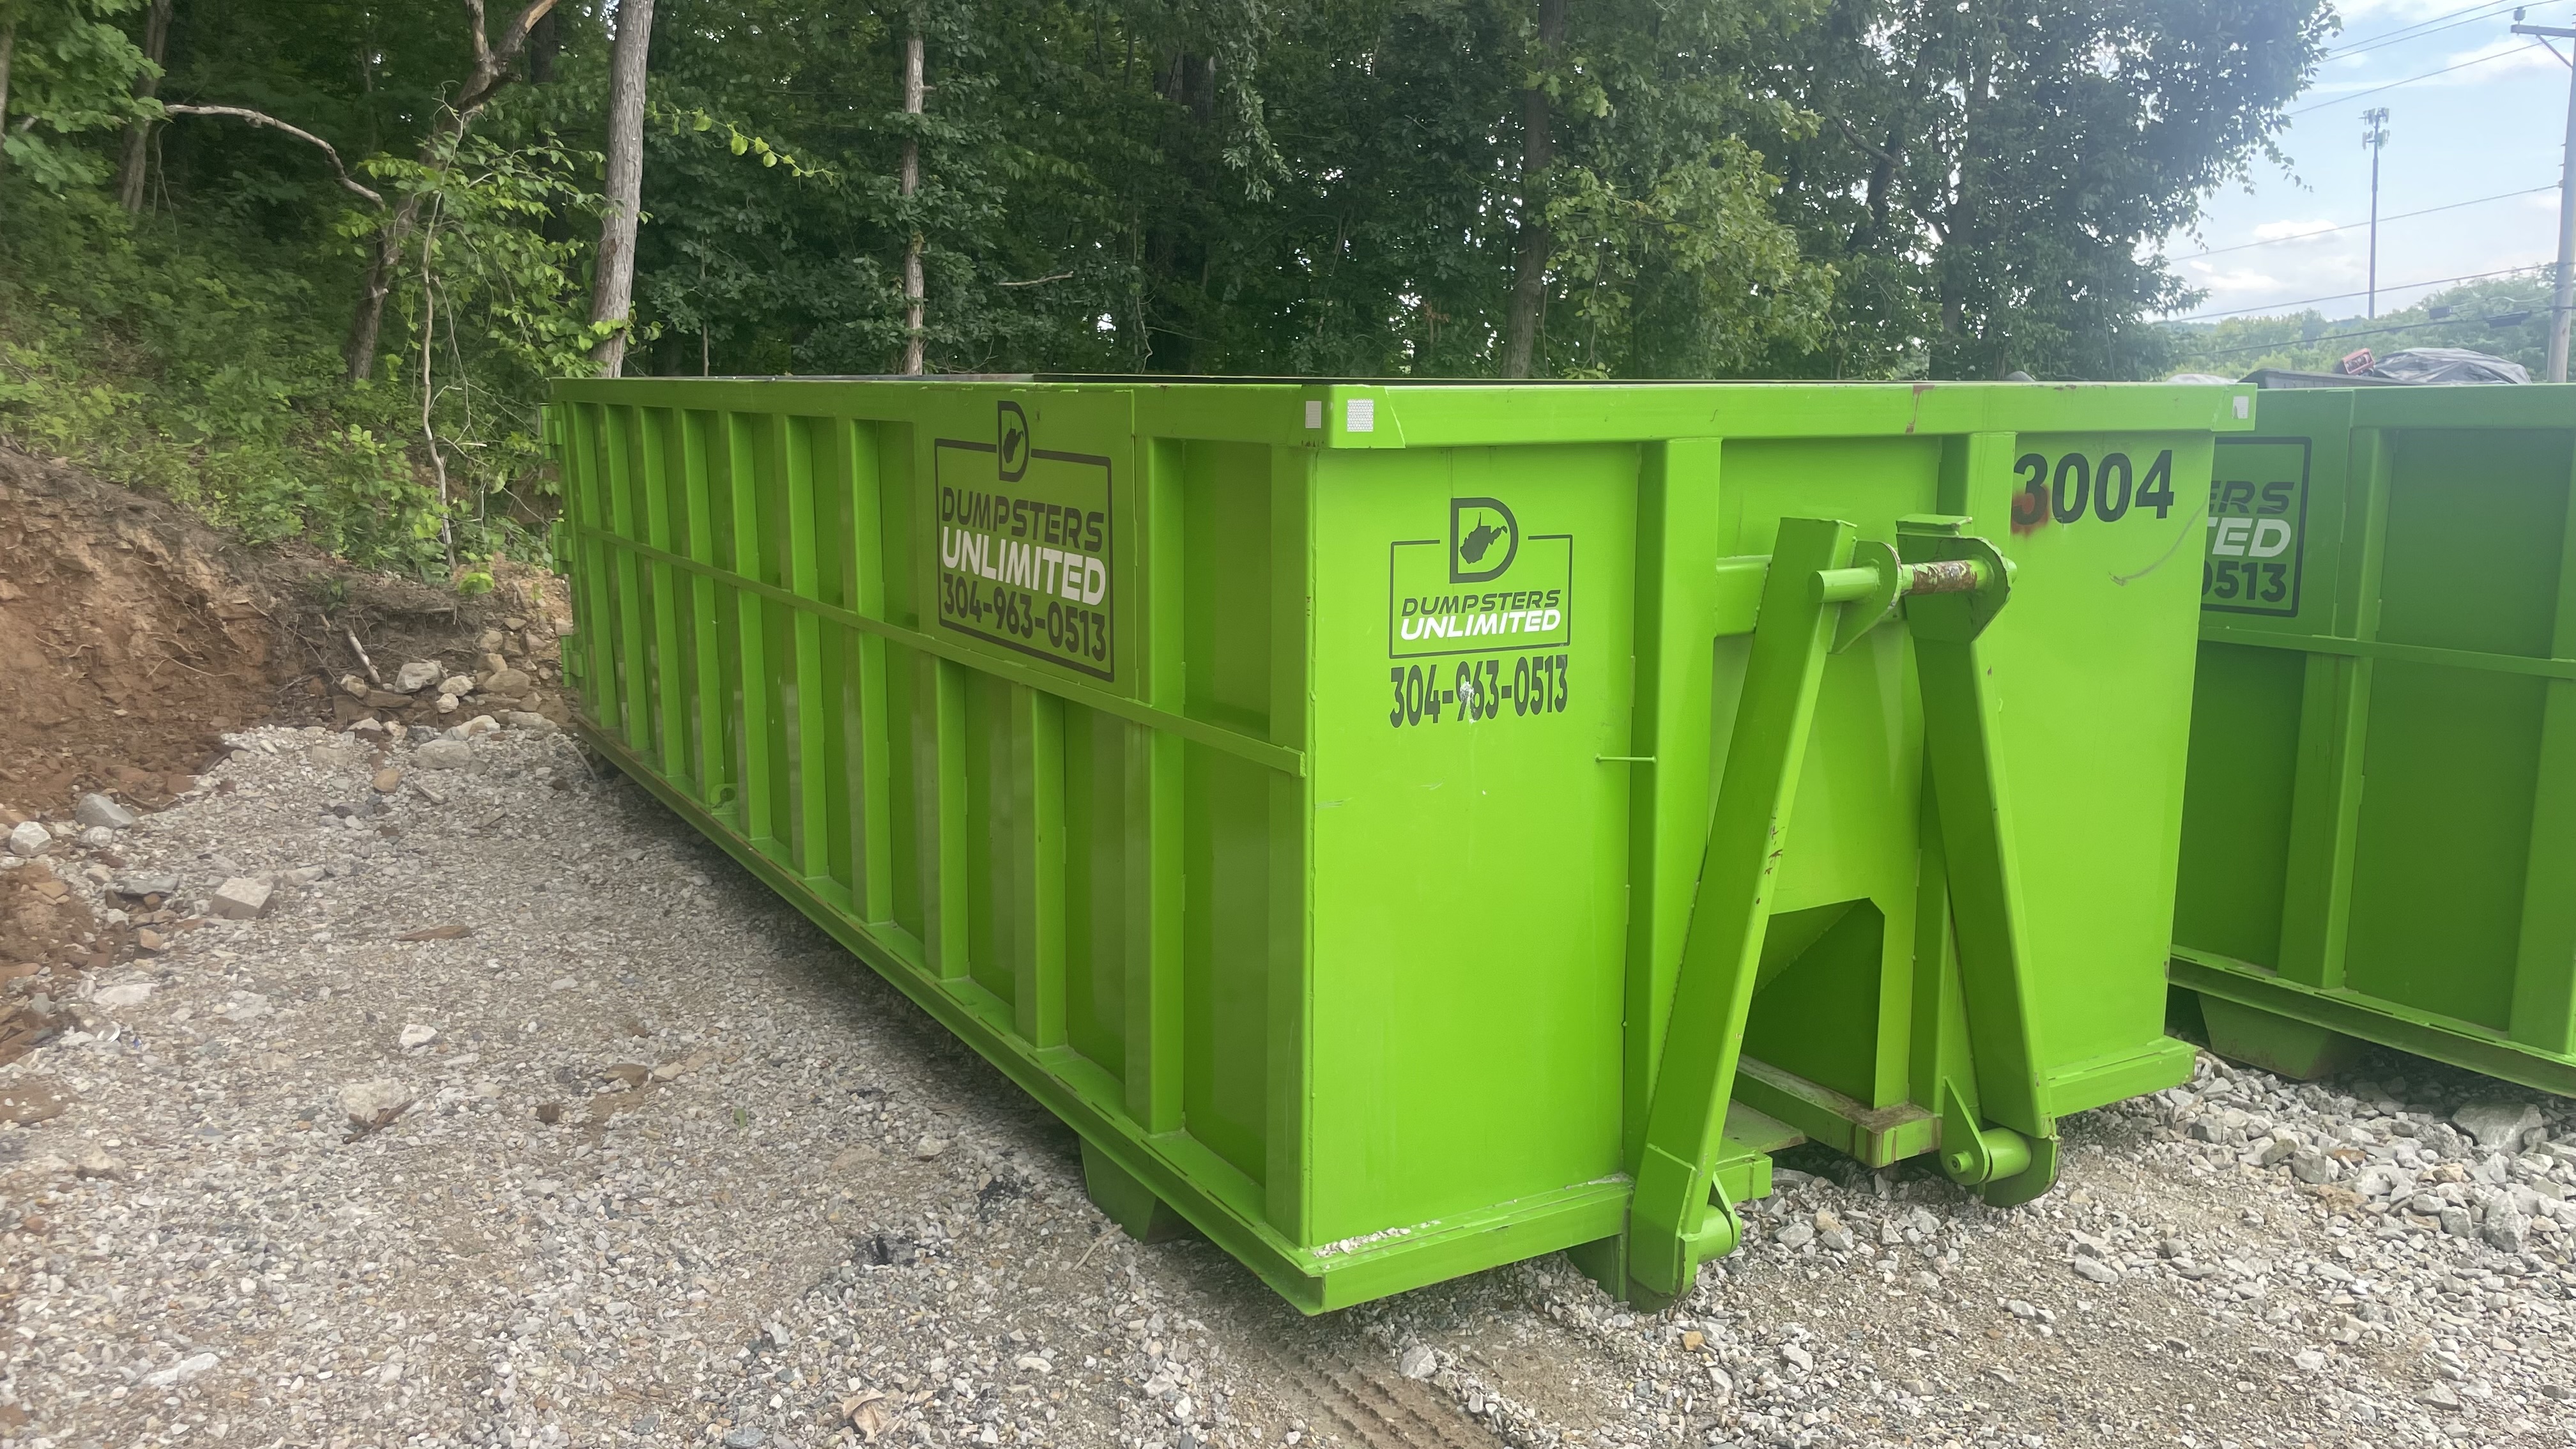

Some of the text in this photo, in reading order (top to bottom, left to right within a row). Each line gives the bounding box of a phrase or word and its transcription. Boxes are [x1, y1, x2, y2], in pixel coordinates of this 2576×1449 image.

[998, 401, 1029, 482] D
[942, 487, 1104, 552] DUMPSTERS
[2012, 450, 2174, 525] 3004
[942, 526, 1106, 606] UNLIMITED
[1450, 497, 1519, 583] D
[943, 572, 1107, 662] 304-963-0513
[1400, 609, 1561, 641] UNLIMITED
[1402, 590, 1561, 617] DUMPSTERS
[1390, 654, 1568, 728] 304-963-0513
